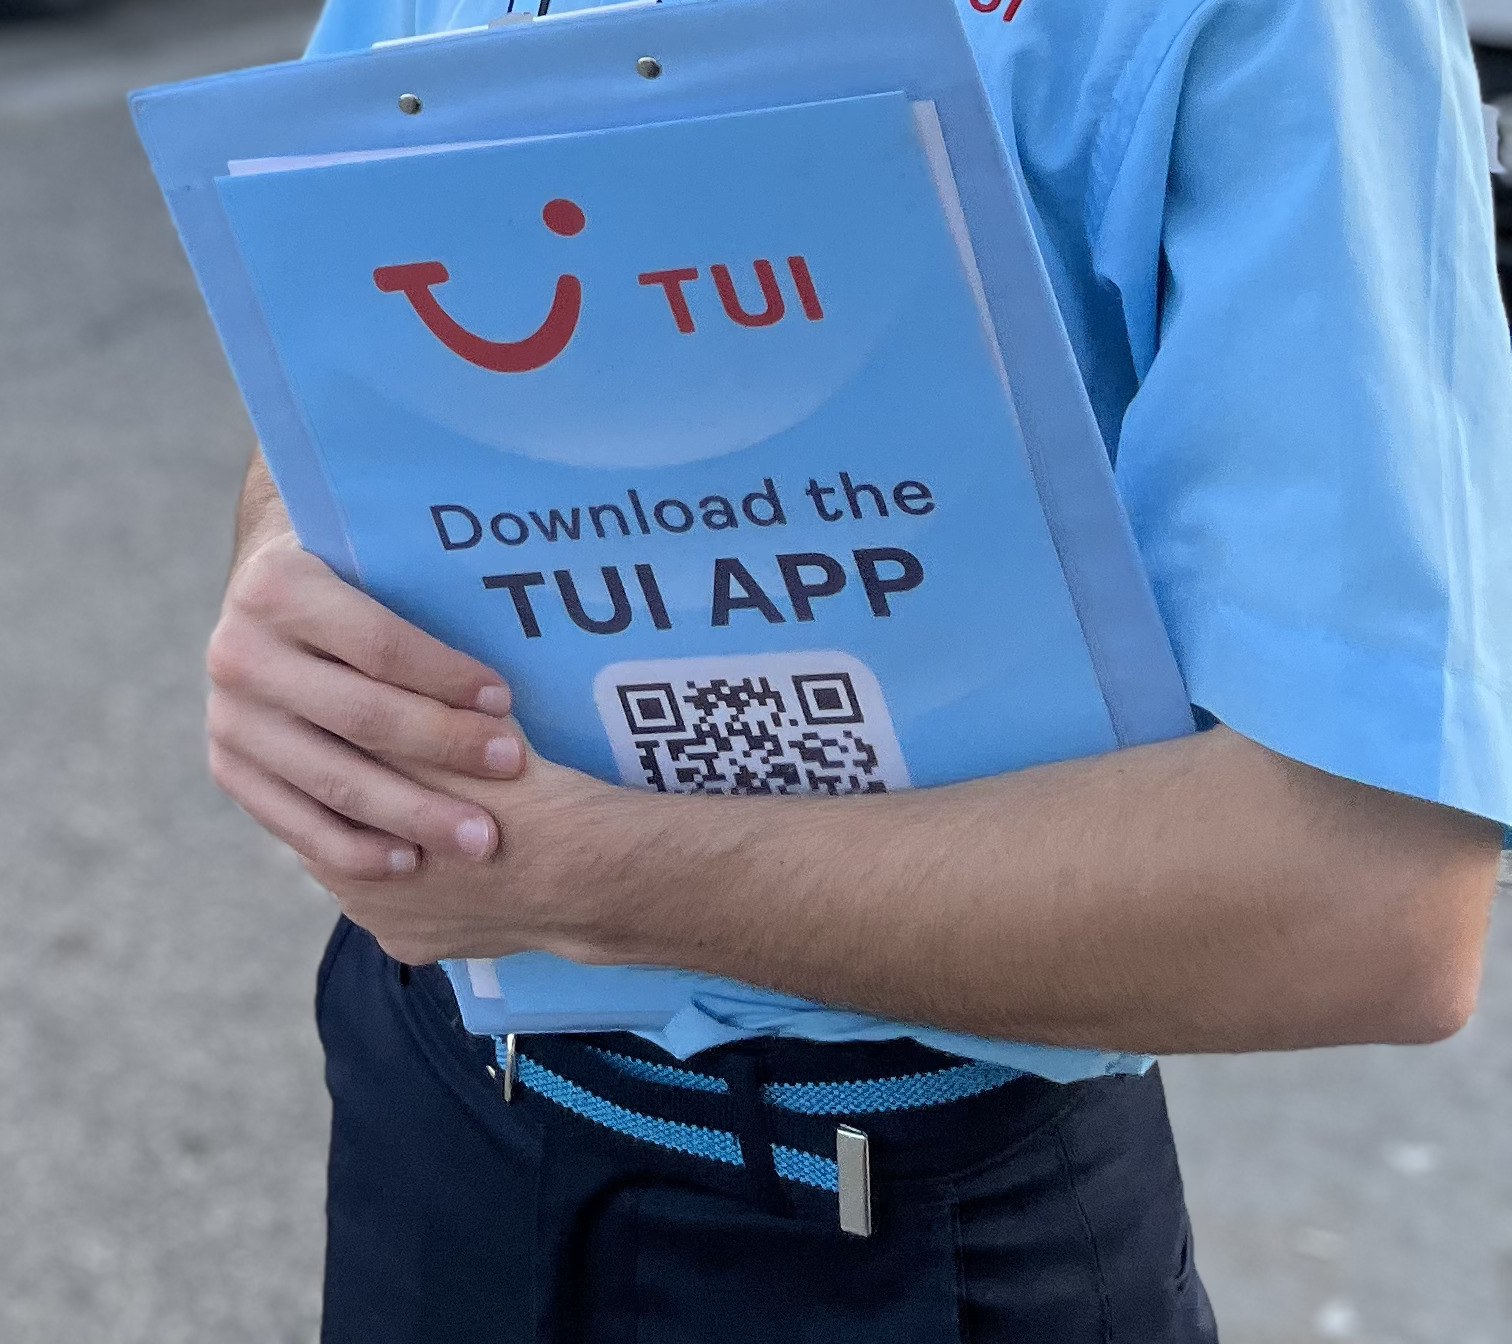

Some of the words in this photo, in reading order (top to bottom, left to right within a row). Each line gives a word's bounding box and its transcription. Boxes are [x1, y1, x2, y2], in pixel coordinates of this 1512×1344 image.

[638, 256, 824, 334] TUI
[429, 477, 787, 551] Download
[805, 471, 935, 522] the
[482, 564, 672, 639] TUI
[711, 547, 924, 628] APP
